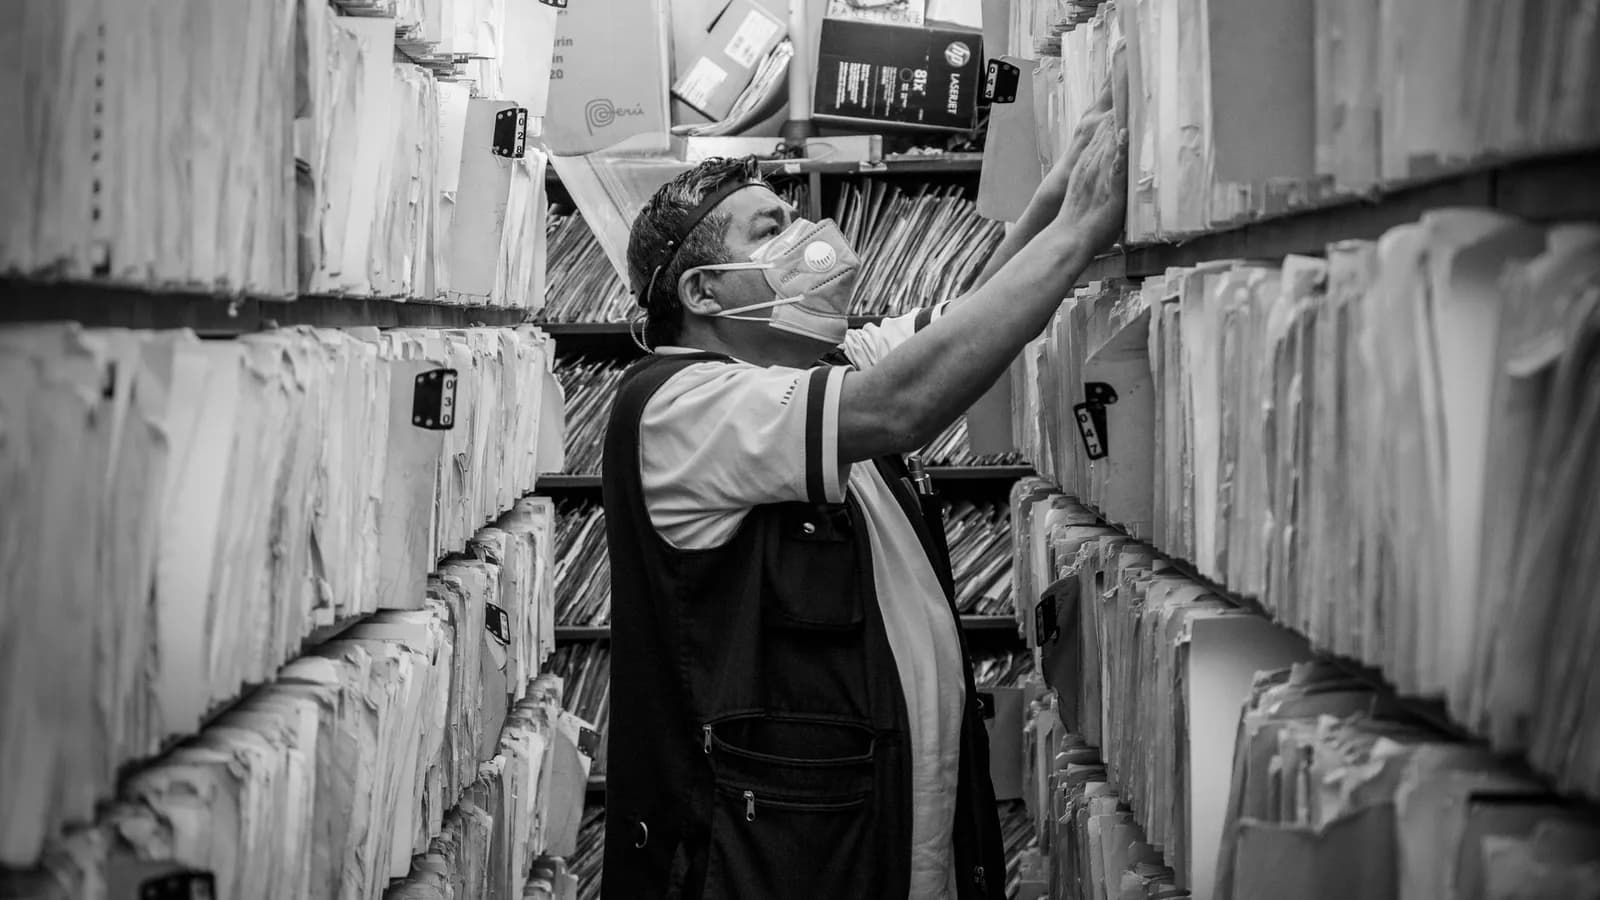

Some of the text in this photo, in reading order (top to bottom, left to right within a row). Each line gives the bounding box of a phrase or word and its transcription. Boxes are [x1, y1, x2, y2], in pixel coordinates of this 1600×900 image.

[945, 43, 970, 67] hp
[947, 73, 960, 114] LASERJET
[443, 380, 454, 424] 030
[1080, 414, 1098, 453] 047
